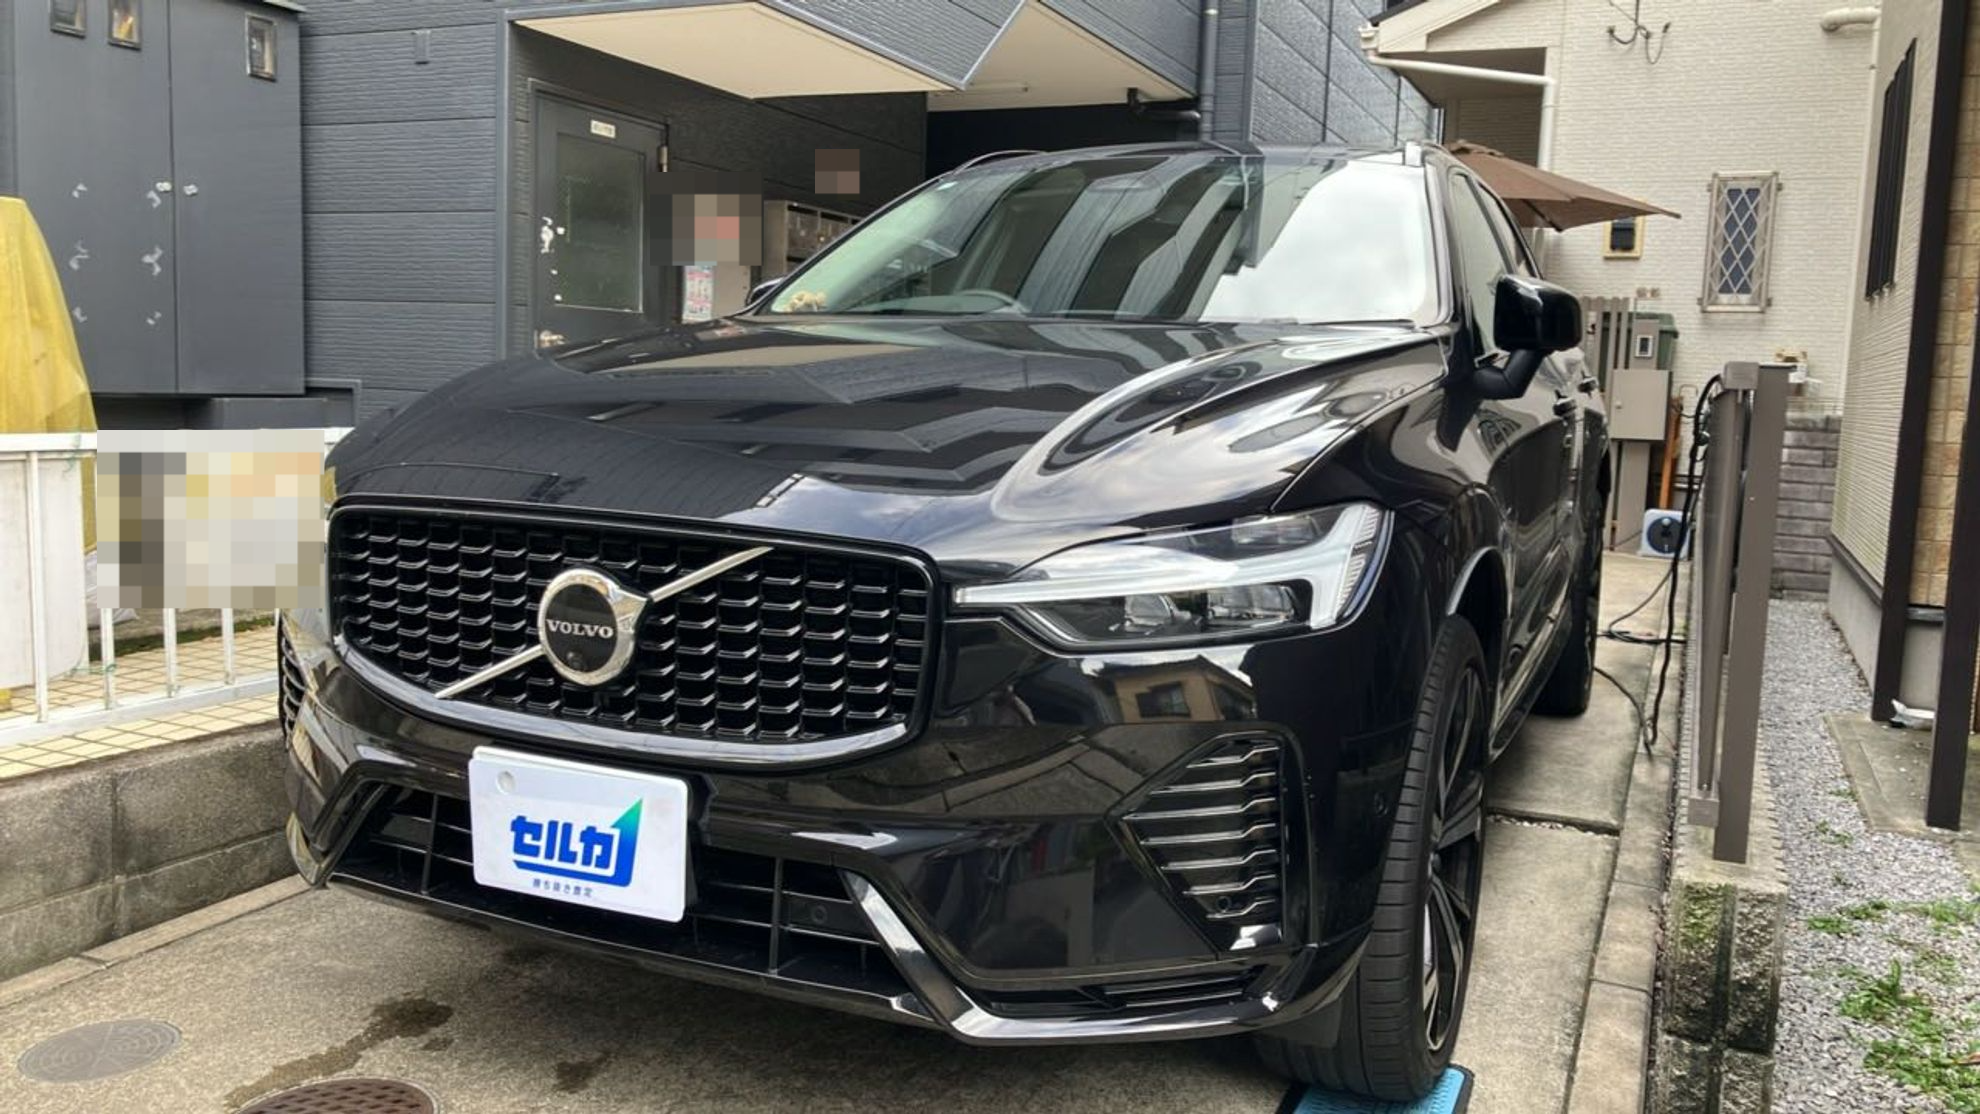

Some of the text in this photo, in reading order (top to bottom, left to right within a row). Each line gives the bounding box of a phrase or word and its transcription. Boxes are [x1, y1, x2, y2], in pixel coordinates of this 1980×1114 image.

[546, 618, 614, 639] VOLVO
[510, 815, 614, 870] セルカ
